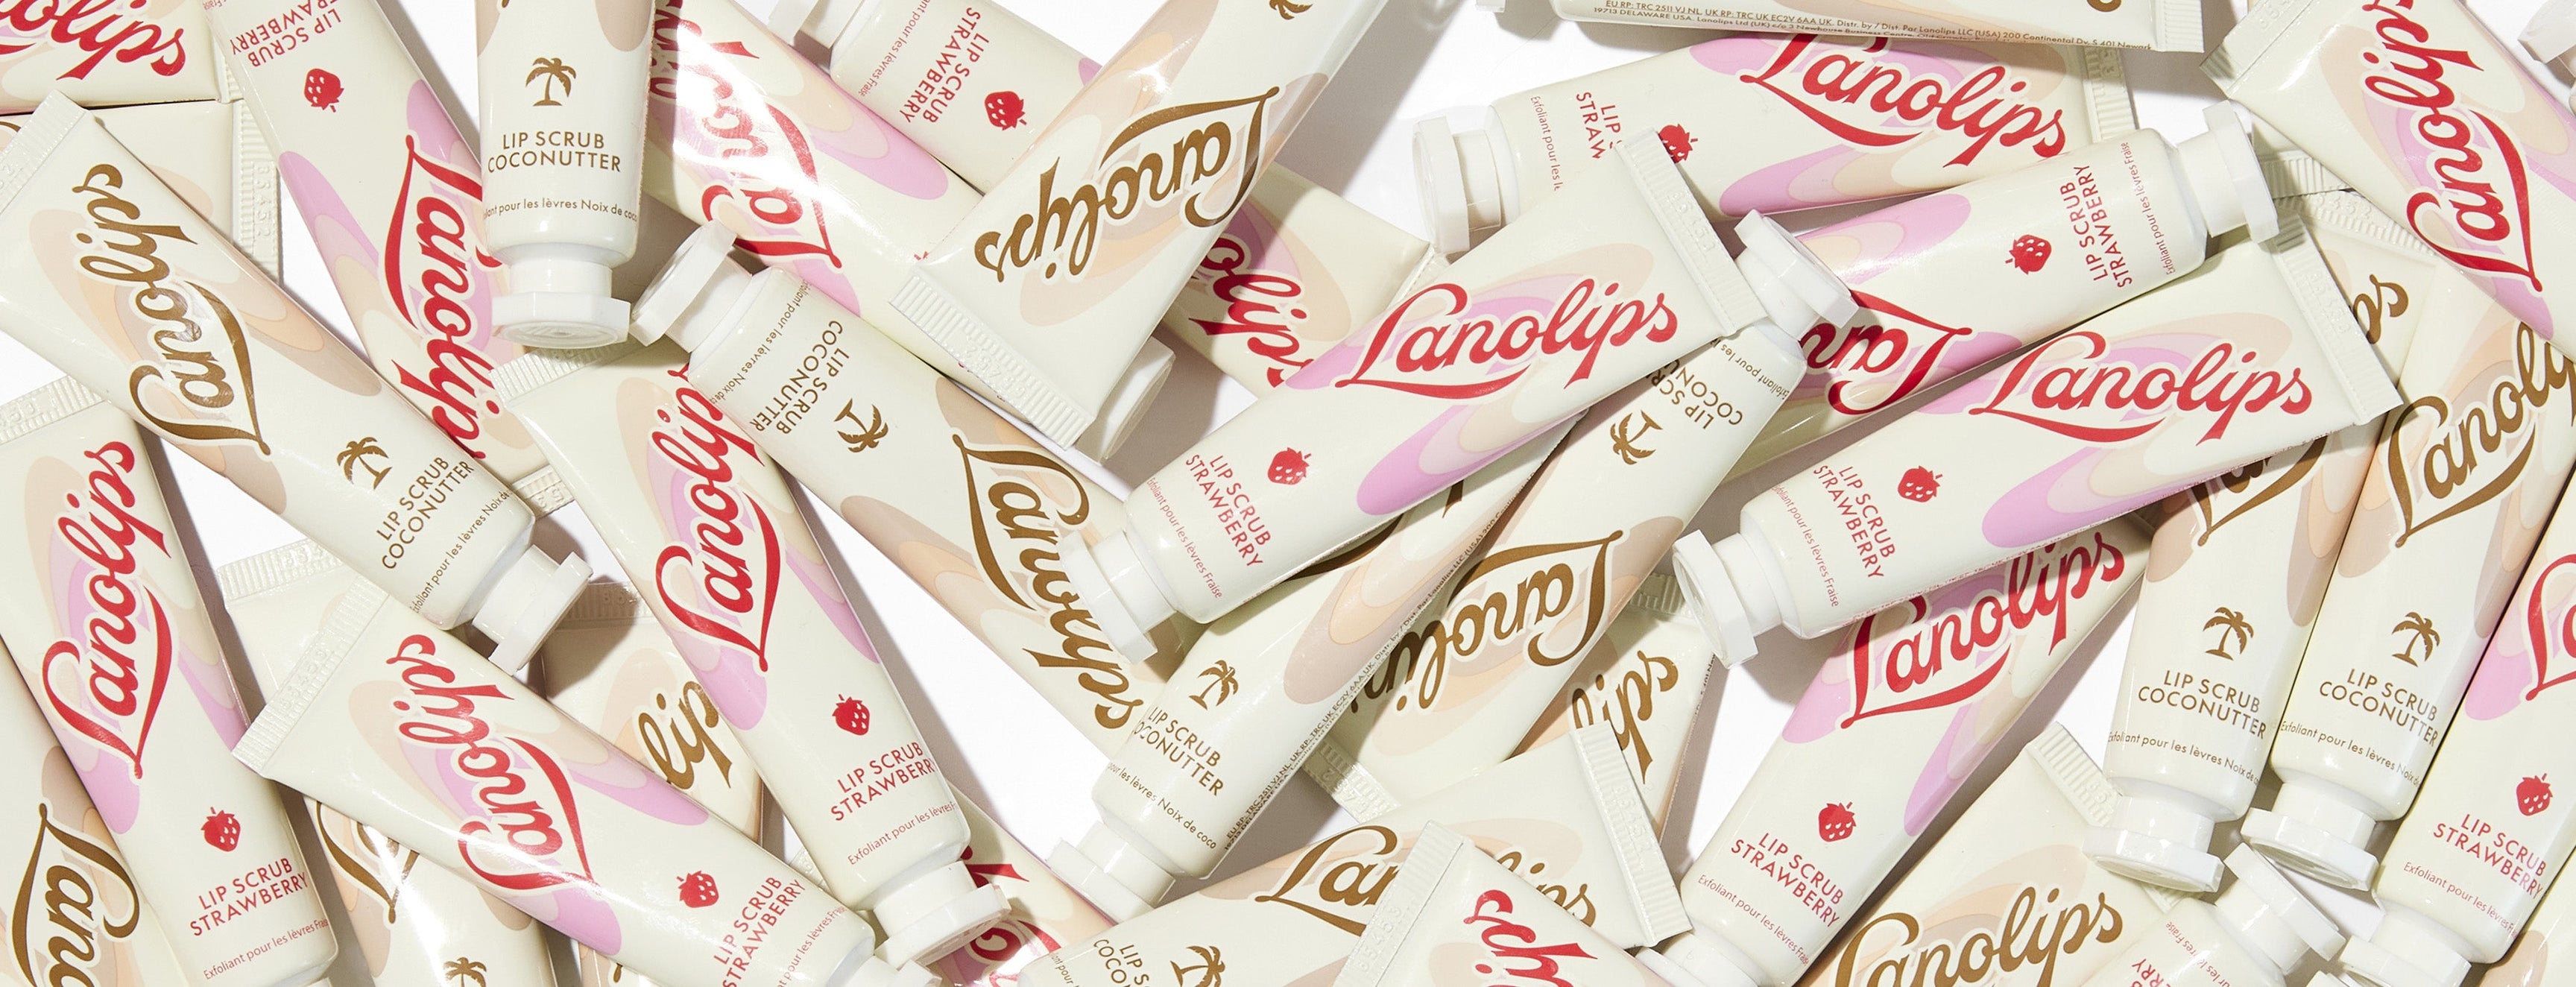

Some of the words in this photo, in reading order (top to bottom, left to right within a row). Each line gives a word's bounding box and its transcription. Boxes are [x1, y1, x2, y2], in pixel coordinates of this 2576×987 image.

[230, 0, 338, 59] RAWBERRY
[247, 27, 309, 67] SCRUB
[314, 8, 341, 34] LIP
[891, 37, 908, 53] les
[902, 10, 921, 38] pour
[966, 33, 990, 63] LIP
[1704, 8, 1719, 17] UK
[1735, 10, 1754, 21] TRC
[1755, 12, 1771, 22] UK
[1771, 13, 1795, 23] EC2V
[1860, 21, 1873, 32] by
[1957, 28, 1972, 37] LLC
[2001, 31, 2021, 41] 200
[871, 51, 897, 80] lèvres
[899, 7, 981, 123] STRAWBERRY
[922, 63, 970, 123] SCRUB
[1576, 92, 1606, 160] STRAW
[1600, 104, 1621, 133] LIP
[1740, 34, 2066, 168] Lanolips
[487, 150, 621, 174] COCONUTTER
[503, 132, 528, 150] LIP
[535, 130, 604, 149] SCRUB
[1541, 136, 1557, 162] pour
[1550, 164, 1561, 180] les
[499, 202, 521, 216] pour
[523, 198, 539, 209] les
[542, 198, 578, 209] lèvres
[581, 199, 609, 213] Noix
[974, 86, 1279, 282] Lanolips
[2139, 196, 2152, 213] les
[2059, 178, 2095, 248] SCRUB
[2073, 165, 2133, 288] STRAWBERRY
[2146, 214, 2165, 239] pour
[2085, 253, 2109, 281] LIP
[72, 163, 273, 455] Lanolips
[765, 328, 783, 344] les
[777, 303, 796, 329] pour
[741, 344, 771, 373] lèvres
[826, 347, 850, 377] LIP
[1334, 280, 1679, 399] Lanolips
[722, 372, 746, 394] Noix
[749, 321, 843, 432] COCONUTTER
[1645, 368, 1688, 406] SCR
[1657, 359, 1743, 426] COCONU
[1969, 330, 2312, 446] Lanolips
[776, 376, 828, 435] SCRUB
[1685, 405, 1714, 430] LIP
[376, 511, 401, 541] LIP
[399, 457, 449, 511] SCRUB
[382, 461, 475, 570] COCONUTTER
[1185, 454, 1263, 567] STRAWBERRY
[1209, 455, 1234, 479] LIP
[1225, 482, 1271, 546] SCRUB
[1813, 465, 1884, 578] STRAWBERRY
[1838, 466, 1863, 489] LIP
[1855, 493, 1895, 558] SCRUB
[431, 558, 450, 585] pour
[445, 543, 463, 559] les
[457, 514, 487, 544] lèvres
[481, 497, 504, 517] Noix
[1159, 504, 1180, 527] pour
[1175, 526, 1189, 543] les
[1184, 541, 1208, 574] lèvres
[1202, 572, 1222, 599] Fraise
[1787, 507, 1808, 529] pour
[1802, 529, 1816, 545] les
[1810, 543, 1829, 578] lèvres
[1824, 577, 1840, 608] Fraise
[42, 441, 171, 779] Lanolips
[1841, 532, 2124, 728] Lanolips
[2138, 686, 2267, 740] COCONUTTER
[2163, 669, 2194, 689] LIP
[2198, 678, 2260, 713] SCRUB
[2319, 681, 2439, 747] COCONUTTER
[2346, 668, 2378, 690] LIP
[2381, 682, 2437, 722] SCRUB
[386, 634, 590, 891] Lanolips
[837, 768, 865, 793] LIP
[869, 742, 924, 775] SCRUB
[1165, 719, 1221, 767] SCRUB
[2141, 737, 2169, 748] pour
[2171, 740, 2187, 754] les
[2189, 744, 2223, 766] lèvres
[2223, 757, 2246, 777] Noix
[2317, 733, 2346, 748] pour
[2347, 740, 2364, 755] les
[2365, 747, 2396, 770] lèvres
[830, 757, 935, 822] STRAWBERR
[847, 832, 892, 865] Exfoliant
[891, 819, 915, 839] pour
[914, 808, 932, 824] les
[1157, 797, 1184, 823] Noix
[1183, 819, 1197, 833] de
[1196, 831, 1216, 849] coco
[2460, 813, 2492, 837] LIP
[2485, 832, 2546, 877] SCRUB
[198, 886, 227, 910] LIP
[232, 857, 293, 894] SCRUB
[1731, 839, 1840, 927] STRAWBERRY
[1758, 832, 1789, 856] LIP
[1780, 854, 1843, 905] SCRUB
[2403, 861, 2447, 889] Exfoliant
[2446, 883, 2474, 902] pour
[2472, 896, 2487, 912] les
[2433, 823, 2544, 899] STRAWBERRY
[189, 871, 308, 936] STRAWBERRY
[713, 934, 737, 965] LIP
[733, 877, 782, 933] SCRUB
[1697, 874, 1737, 903] Exfoliant
[1734, 899, 1762, 919] pour
[1760, 914, 1775, 931] les
[1773, 925, 1798, 952] lèvres
[203, 954, 246, 980] Exfoliant
[246, 942, 271, 962] pour
[271, 935, 288, 947] les
[286, 924, 315, 941] lèvres
[796, 939, 812, 955] les
[806, 916, 833, 941] lèvres
[1119, 944, 1143, 968] LIP
[2165, 921, 2185, 945] Fraise
